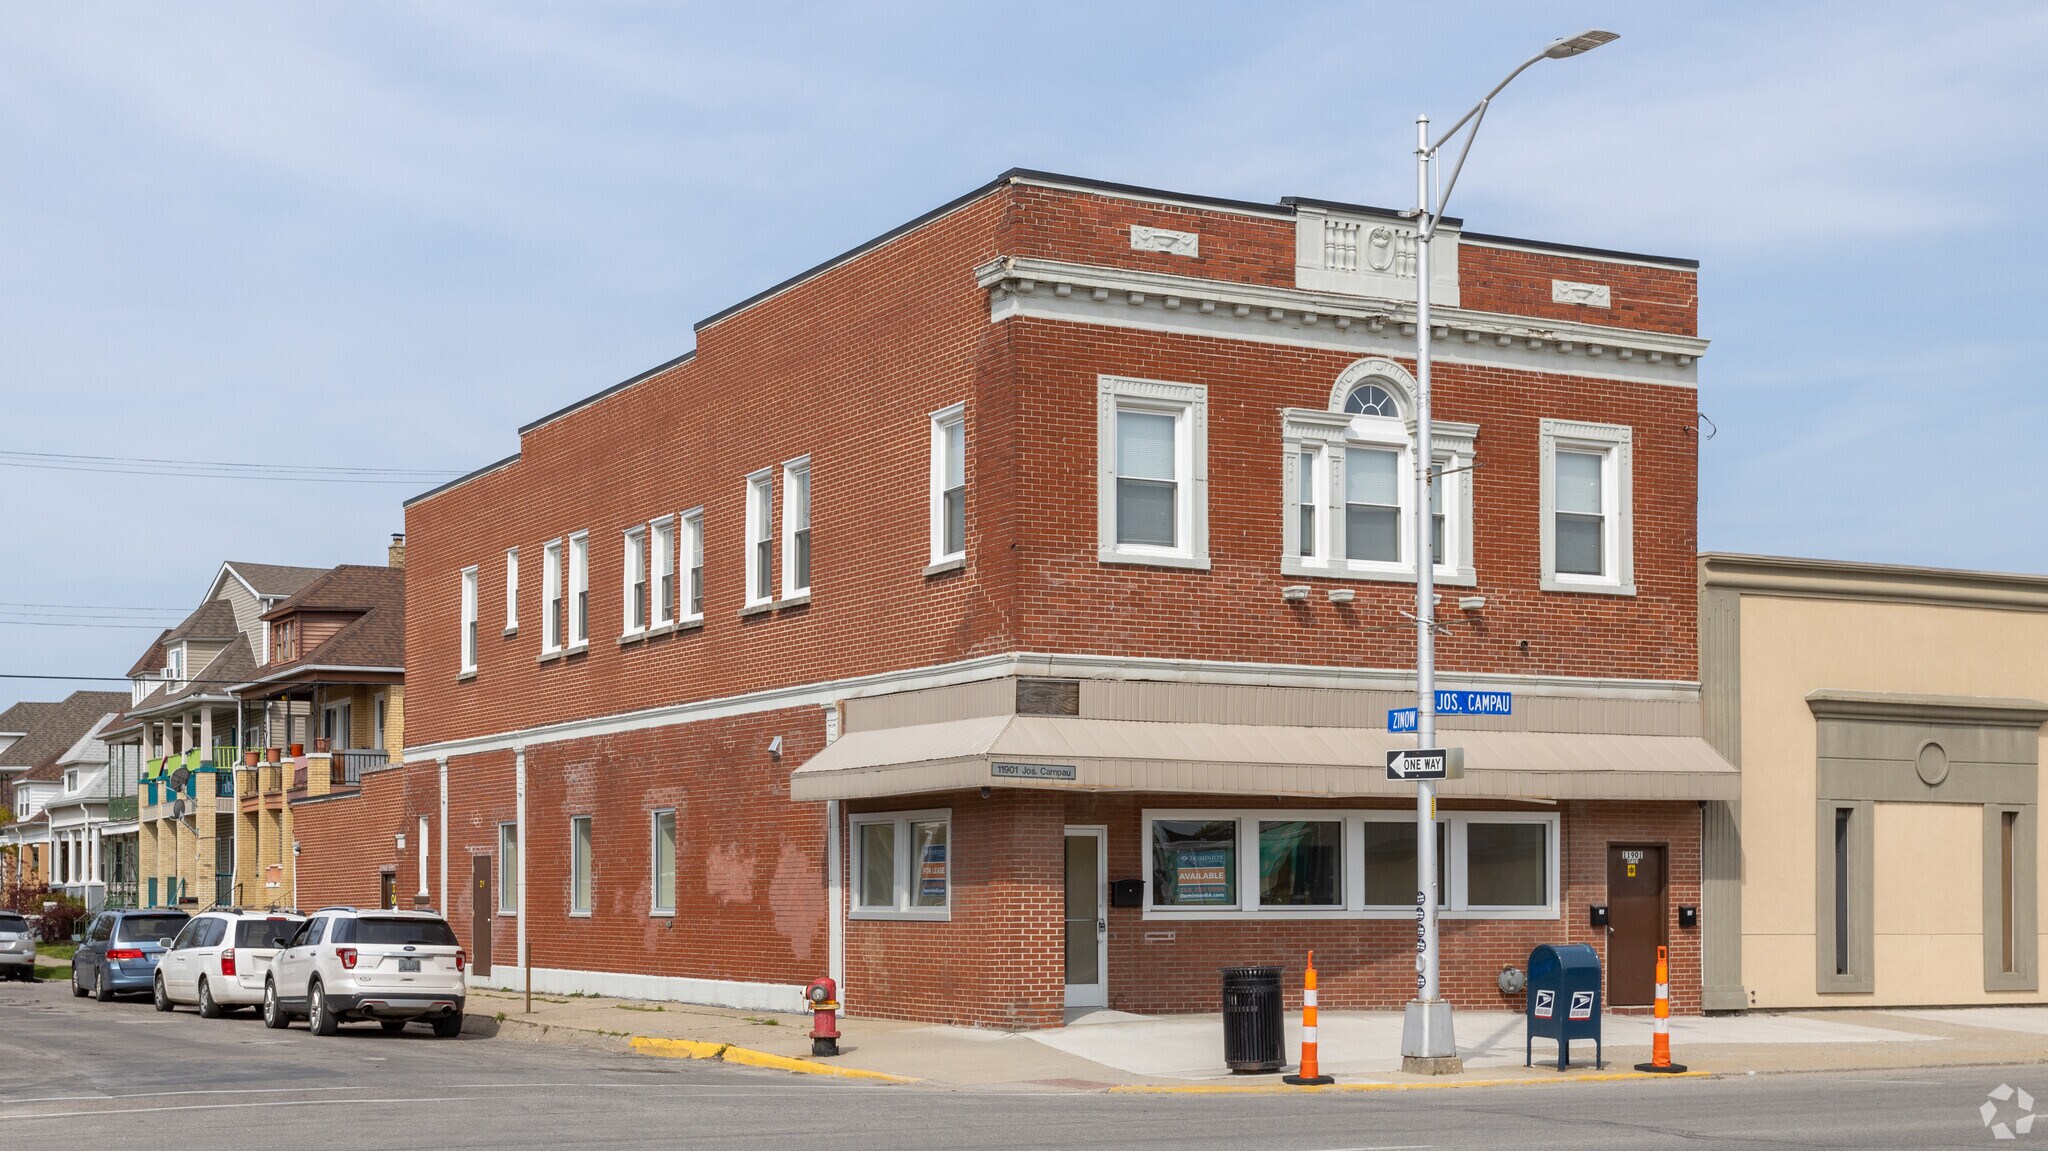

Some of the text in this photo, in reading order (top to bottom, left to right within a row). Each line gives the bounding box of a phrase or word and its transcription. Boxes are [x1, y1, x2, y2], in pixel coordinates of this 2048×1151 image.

[1436, 692, 1510, 712] JOS. CAMPAU
[1392, 710, 1416, 729] ZINOW
[1403, 757, 1442, 771] ONE WAY
[997, 765, 1072, 778] 11901 Jos. Campau
[1622, 851, 1642, 859] 11901
[922, 867, 945, 875] FOR LEASE
[1179, 872, 1225, 880] AVAILABLE
